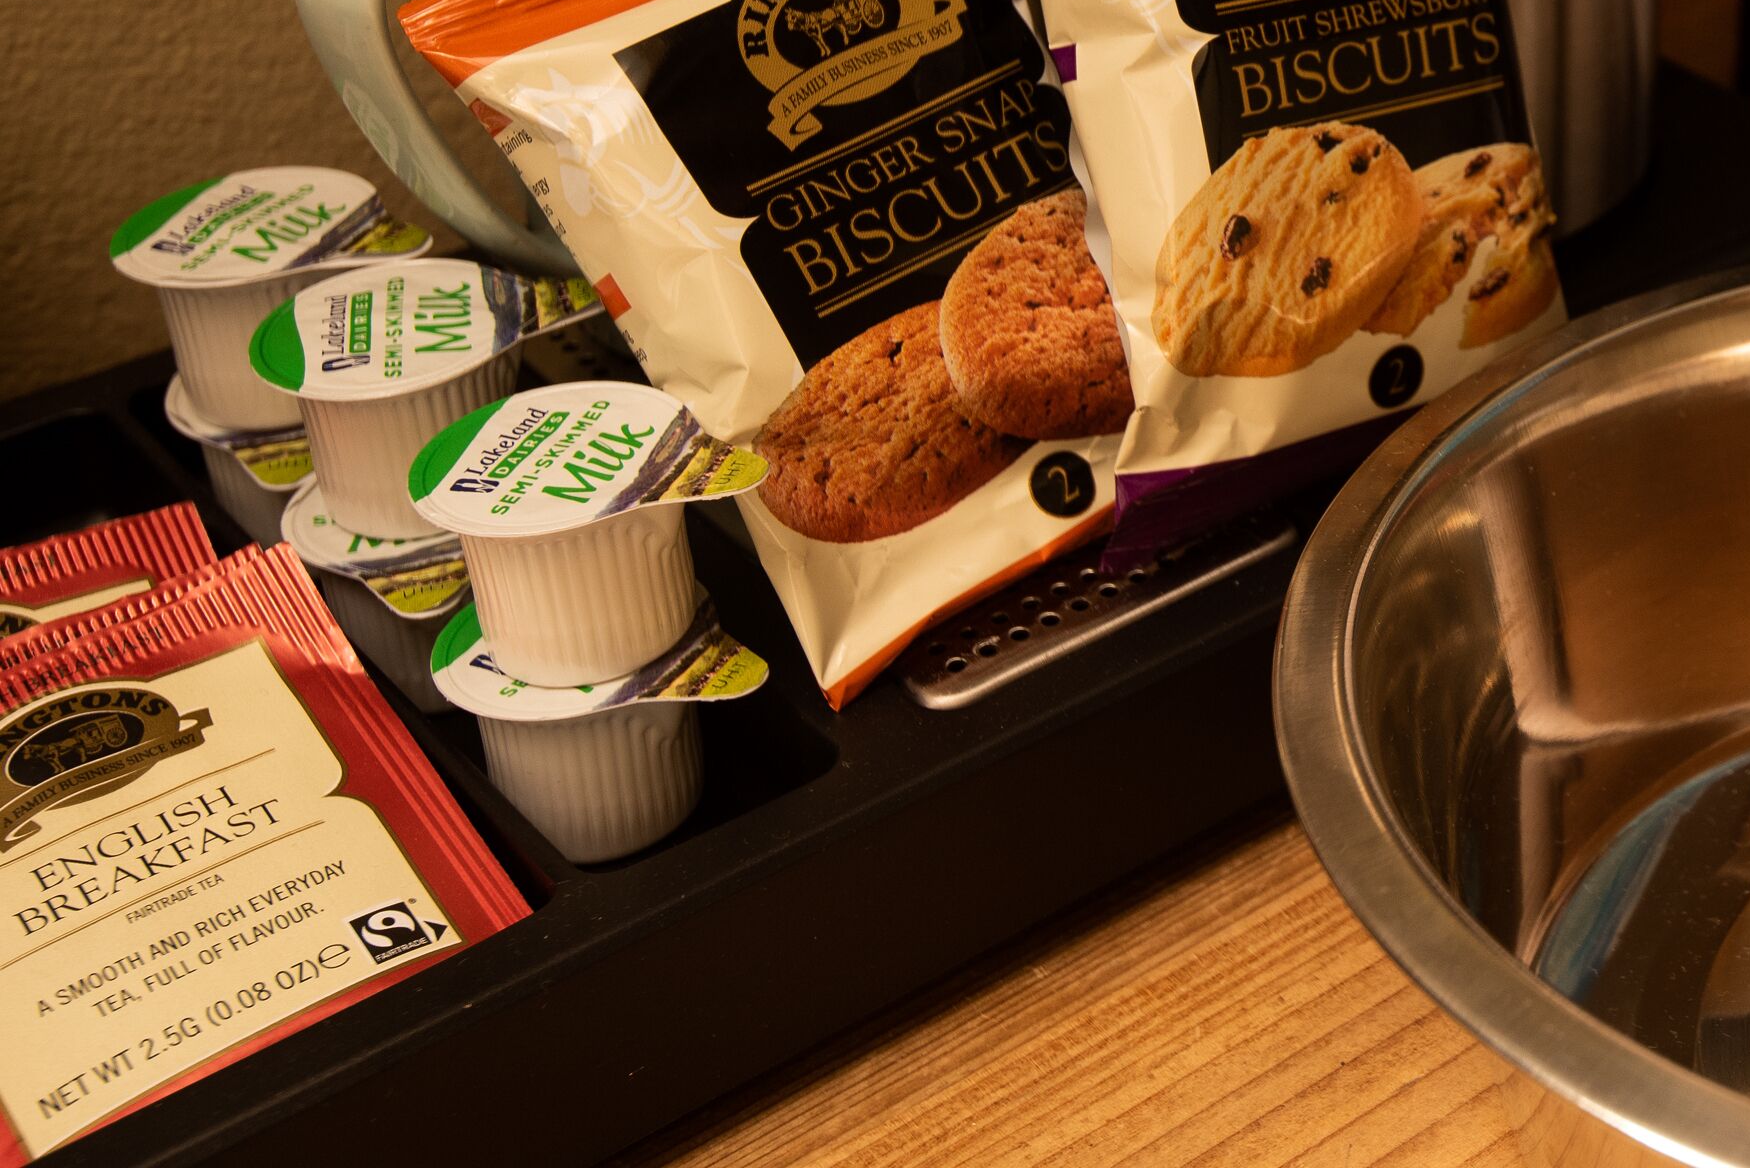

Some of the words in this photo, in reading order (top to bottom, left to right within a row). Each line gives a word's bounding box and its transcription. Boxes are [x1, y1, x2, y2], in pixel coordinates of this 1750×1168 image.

[781, 104, 793, 118] A
[790, 68, 829, 110] FAMILY
[829, 48, 889, 83] BUSINESS
[888, 31, 928, 57] SINCE
[928, 19, 953, 41] 1907
[1225, 14, 1308, 56] FRUIT
[1231, 11, 1500, 118] BISCUITS
[766, 135, 936, 231] GINGER
[935, 79, 1037, 154] SNAP
[231, 201, 347, 263] Milk
[783, 120, 1069, 296] BISCUITS
[321, 293, 348, 357] Lakeland
[353, 292, 371, 352] DAIRIES
[384, 275, 405, 379] SEMI-SKIMMED
[414, 281, 472, 354] Milk
[1388, 358, 1406, 395] 2
[464, 406, 550, 477] Lakeland
[490, 399, 612, 516] SEMI-SKIMMED
[497, 413, 565, 479] DAIRIES
[541, 422, 656, 505] Milk
[714, 459, 747, 486] UHT
[1046, 465, 1081, 504] 2
[711, 659, 748, 691] UHT
[0, 689, 170, 763] NGTONS
[3, 816, 15, 830] A
[12, 785, 58, 821] FAMILY
[60, 759, 126, 793] BUSINESS
[126, 742, 170, 770] SINCE
[170, 732, 198, 750] 1907
[11, 797, 280, 937] BREAKFAST
[27, 785, 239, 893] ENGLISH
[125, 882, 198, 925] FAIRTRADE
[198, 873, 226, 893] TEA
[36, 999, 55, 1019] A
[55, 950, 146, 1007] SMOOTH
[150, 930, 191, 962] AND
[193, 903, 247, 939] RICH
[248, 859, 348, 914] EVERYDAY
[92, 987, 144, 1019] TEA,
[143, 959, 199, 994] FULL
[198, 942, 225, 966] OF
[227, 901, 325, 953] FLAVOUR.
[374, 936, 429, 963] FAIRTRADE
[36, 1072, 92, 1121] NET
[91, 1047, 136, 1085] WT
[138, 1015, 204, 1062] 2.5G
[204, 980, 273, 1027] (0.08
